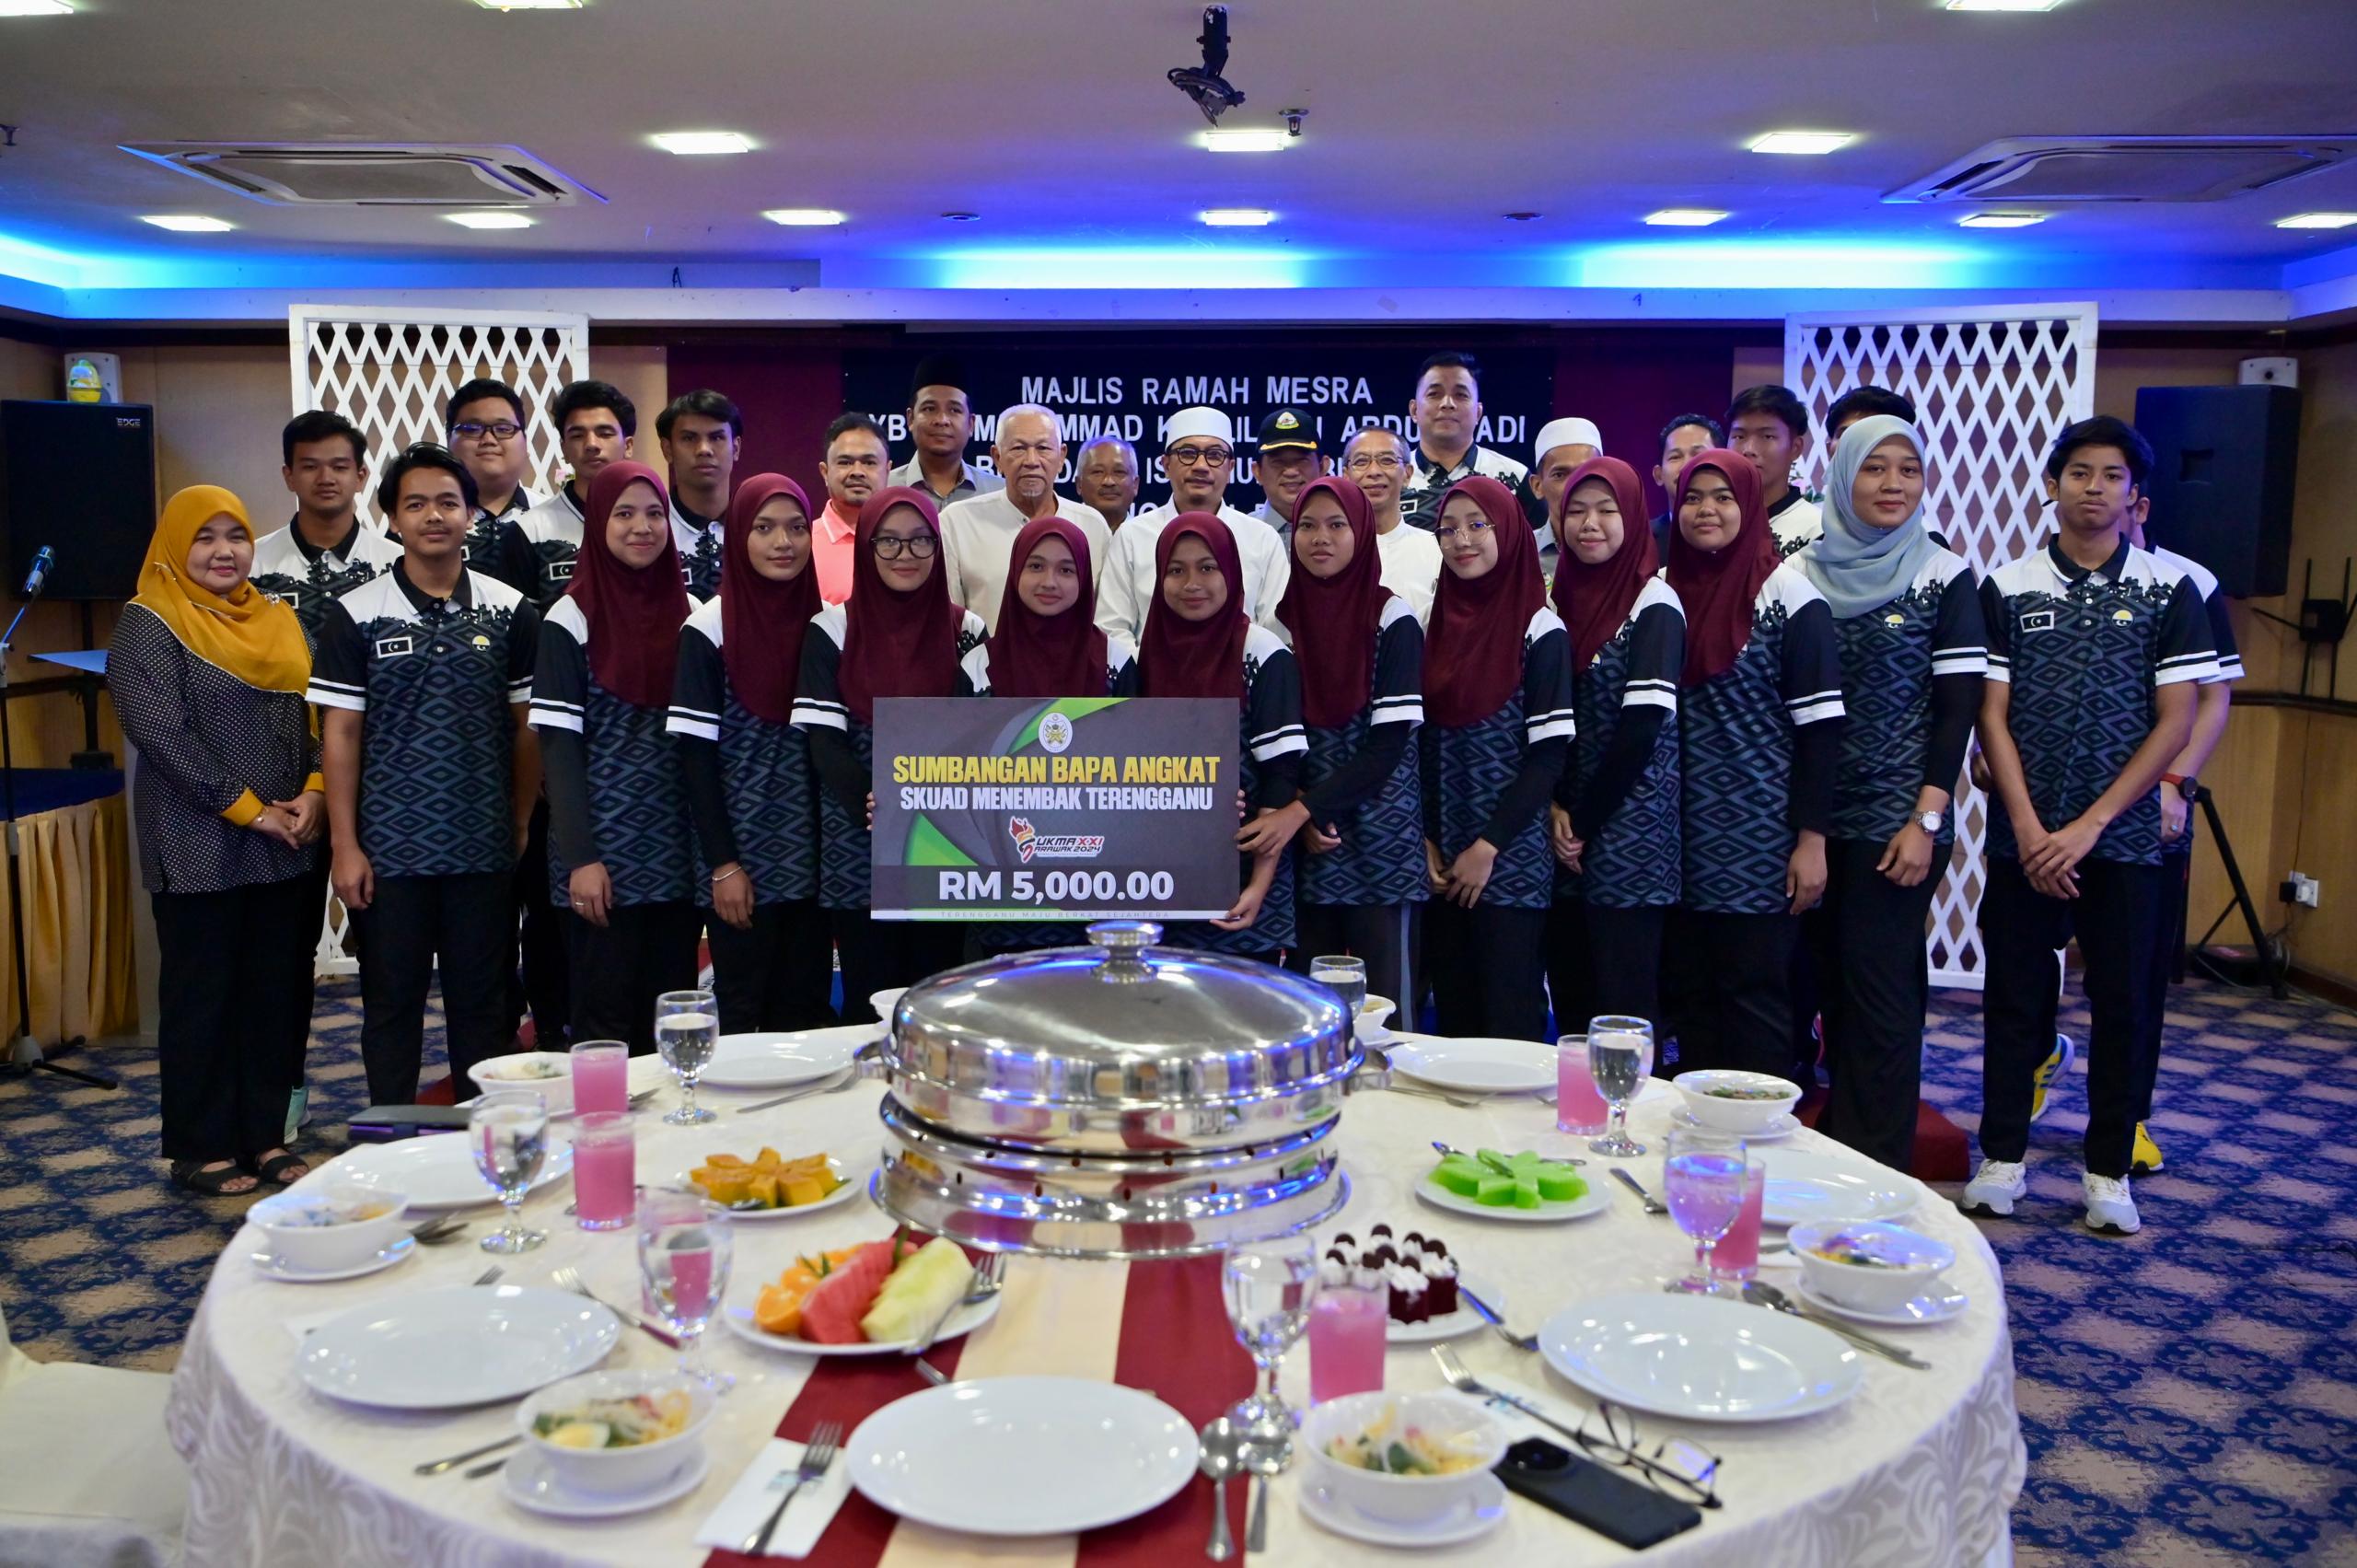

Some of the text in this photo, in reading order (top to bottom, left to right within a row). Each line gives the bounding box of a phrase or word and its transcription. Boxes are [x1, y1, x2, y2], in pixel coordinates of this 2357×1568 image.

[1021, 376, 1373, 404] MAJLIS RAMAH MESRA
[117, 417, 141, 426] EDGE
[1476, 415, 1525, 443] ADI
[893, 756, 1221, 784] SUMBANGAN BAPA ANGKAT
[900, 787, 1213, 810] SKUAD MENEMBAK TERENGGANU
[939, 871, 1174, 905] RM 5,000.00
